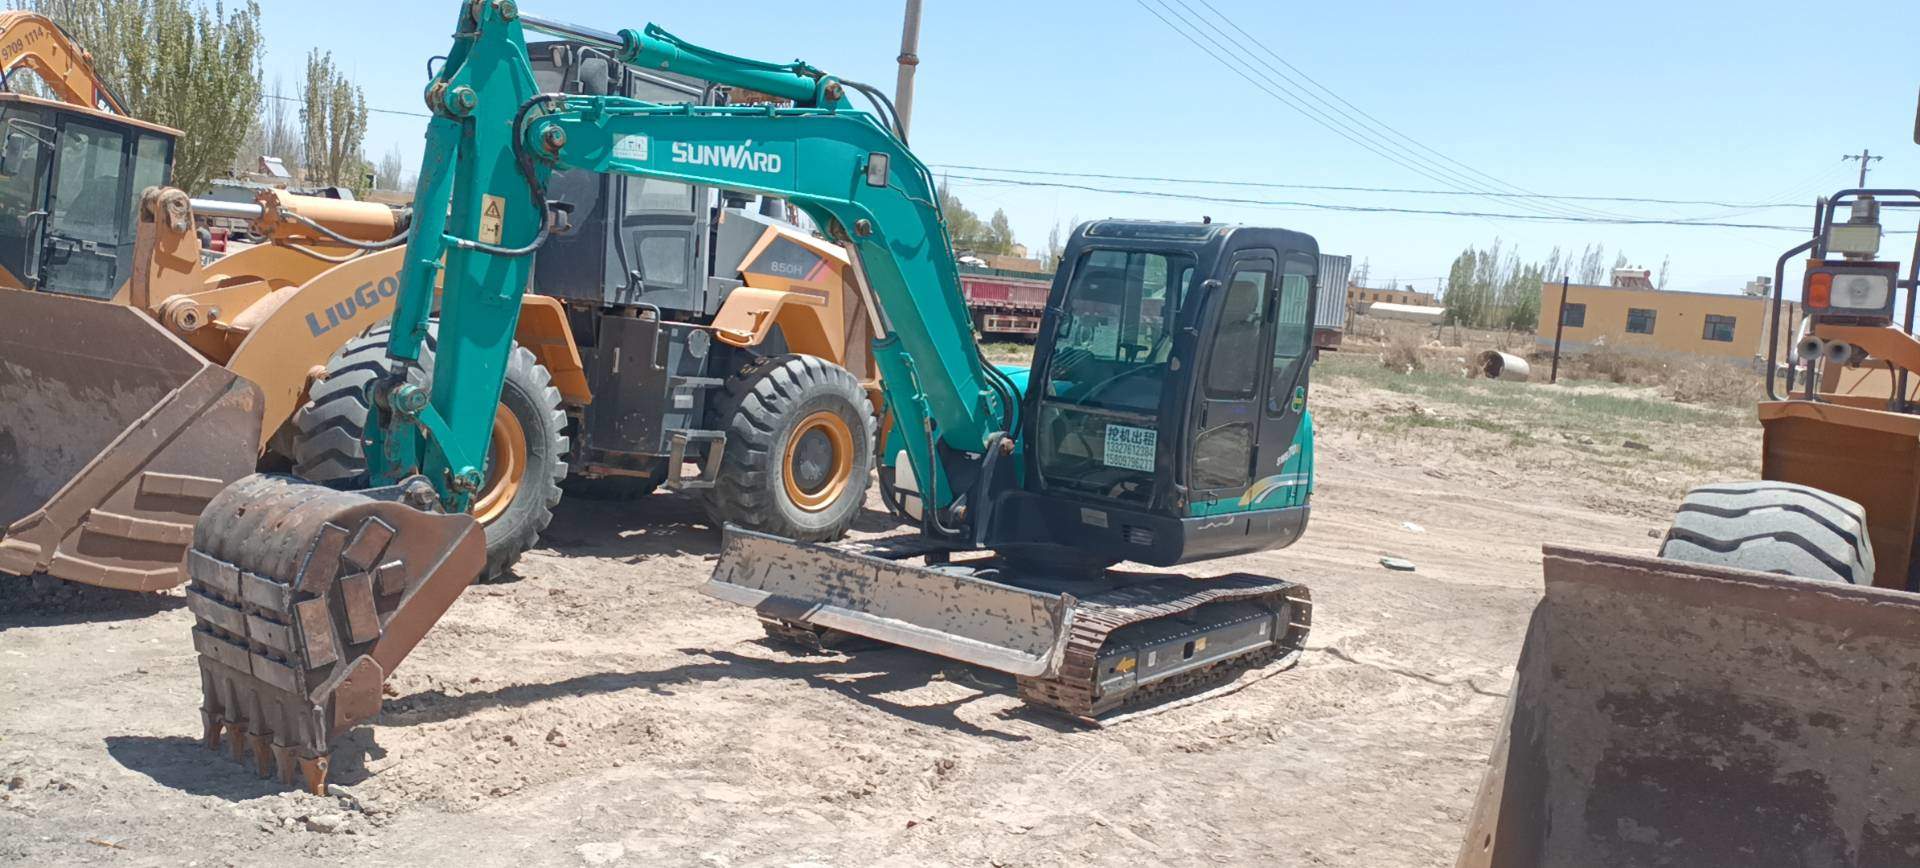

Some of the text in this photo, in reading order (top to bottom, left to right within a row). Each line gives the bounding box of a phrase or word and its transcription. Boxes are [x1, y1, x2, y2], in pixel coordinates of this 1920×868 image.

[1, 38, 24, 61] 9709
[672, 139, 782, 173] SUNWARD
[770, 260, 803, 274] 850H
[305, 270, 401, 338] LIUGO
[1108, 426, 1155, 446] 挖机出租
